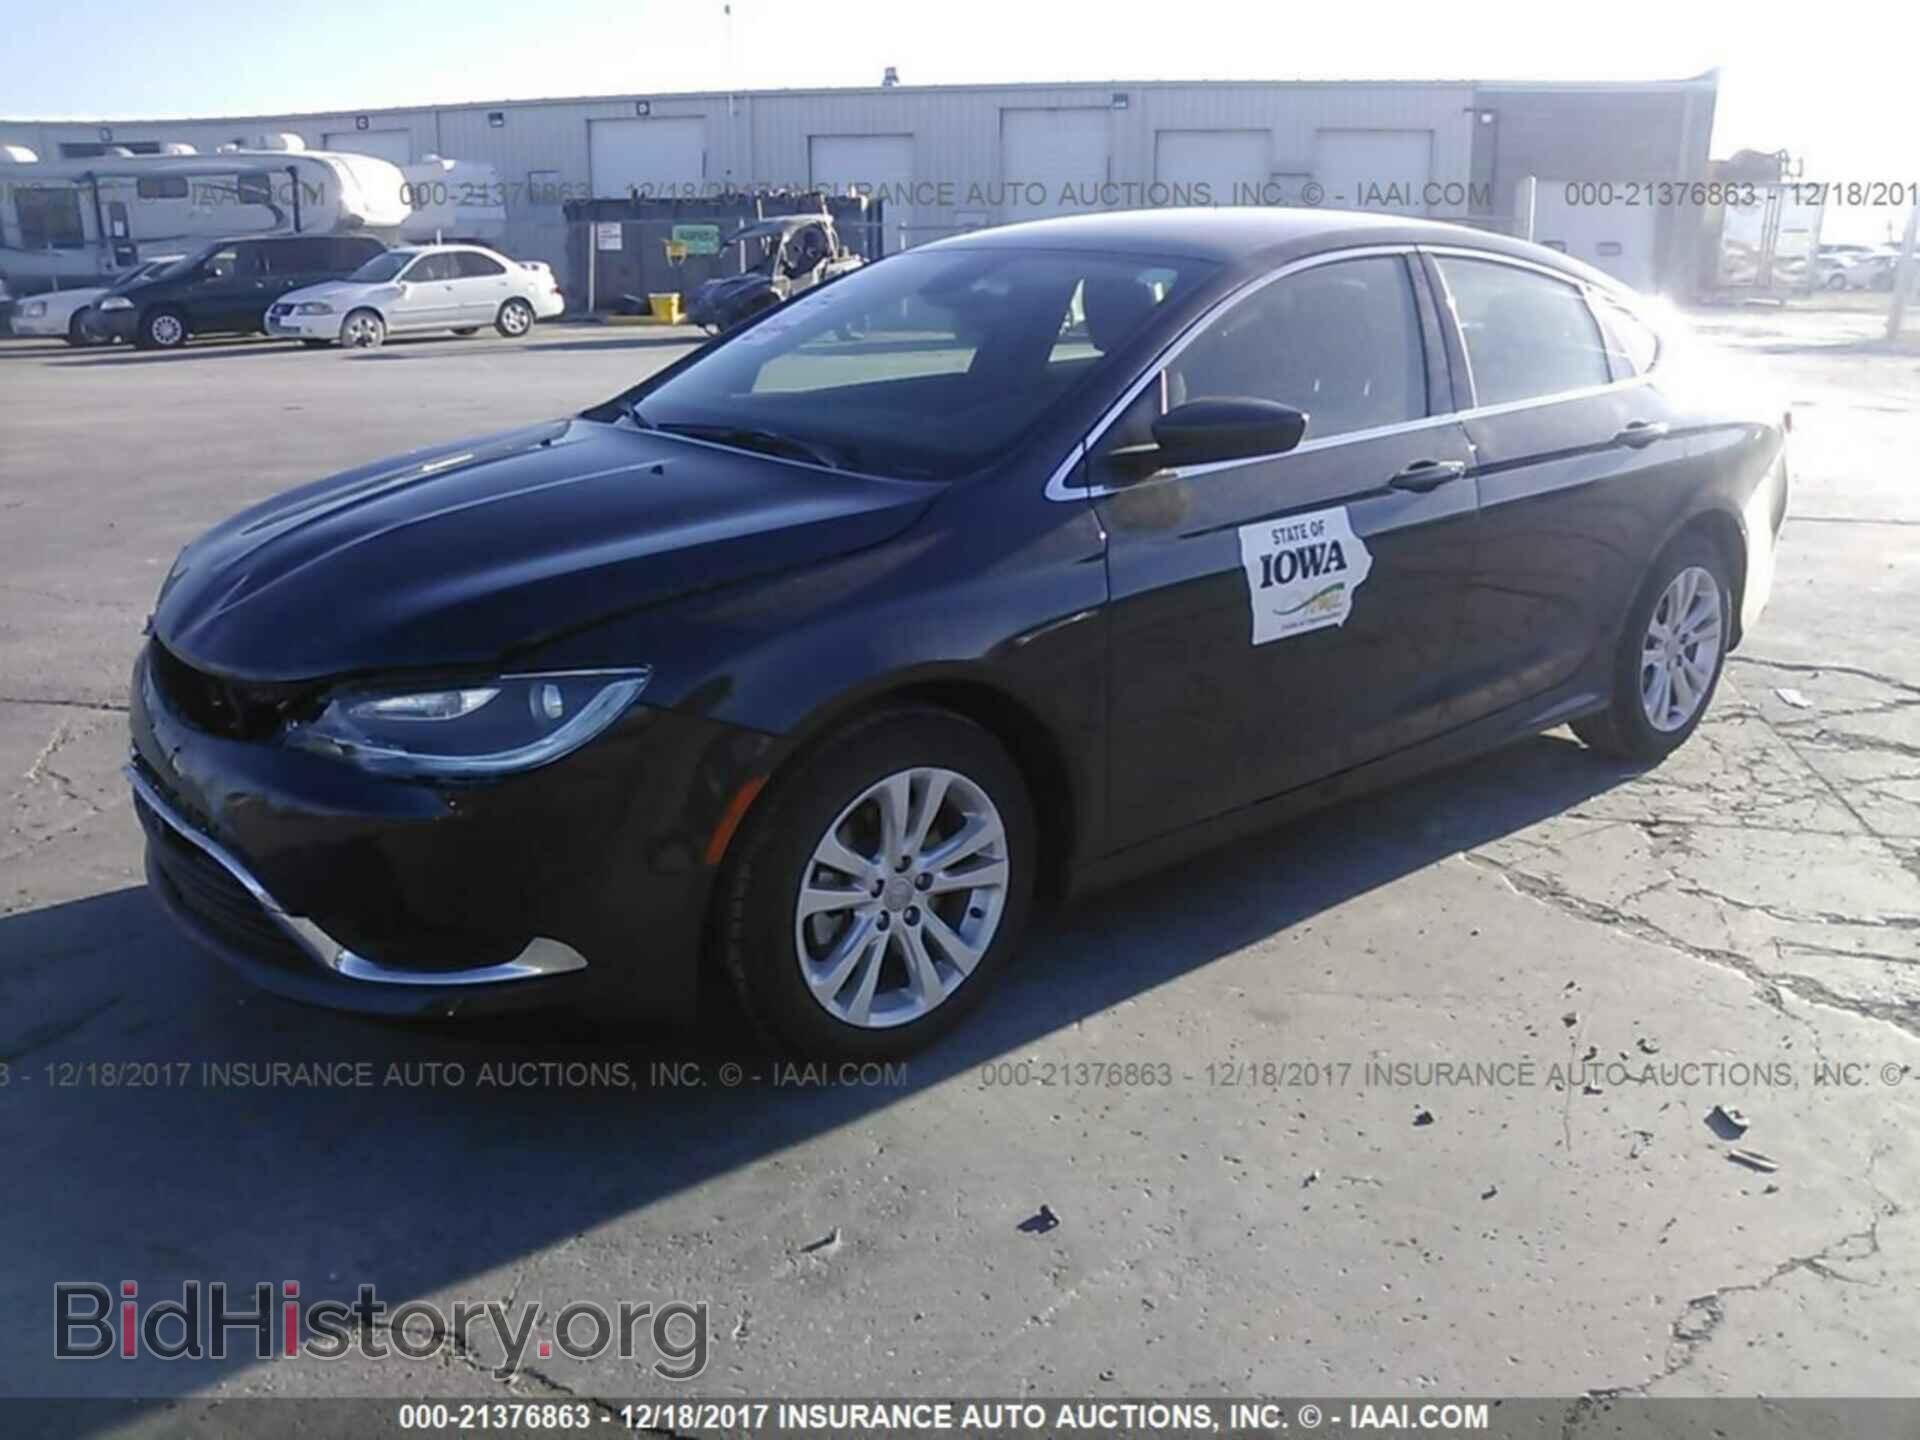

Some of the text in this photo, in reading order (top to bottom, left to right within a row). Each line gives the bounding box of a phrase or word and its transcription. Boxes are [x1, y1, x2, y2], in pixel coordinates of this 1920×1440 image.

[1272, 519, 1325, 545] STATE OF
[1259, 539, 1347, 589] IOWA
